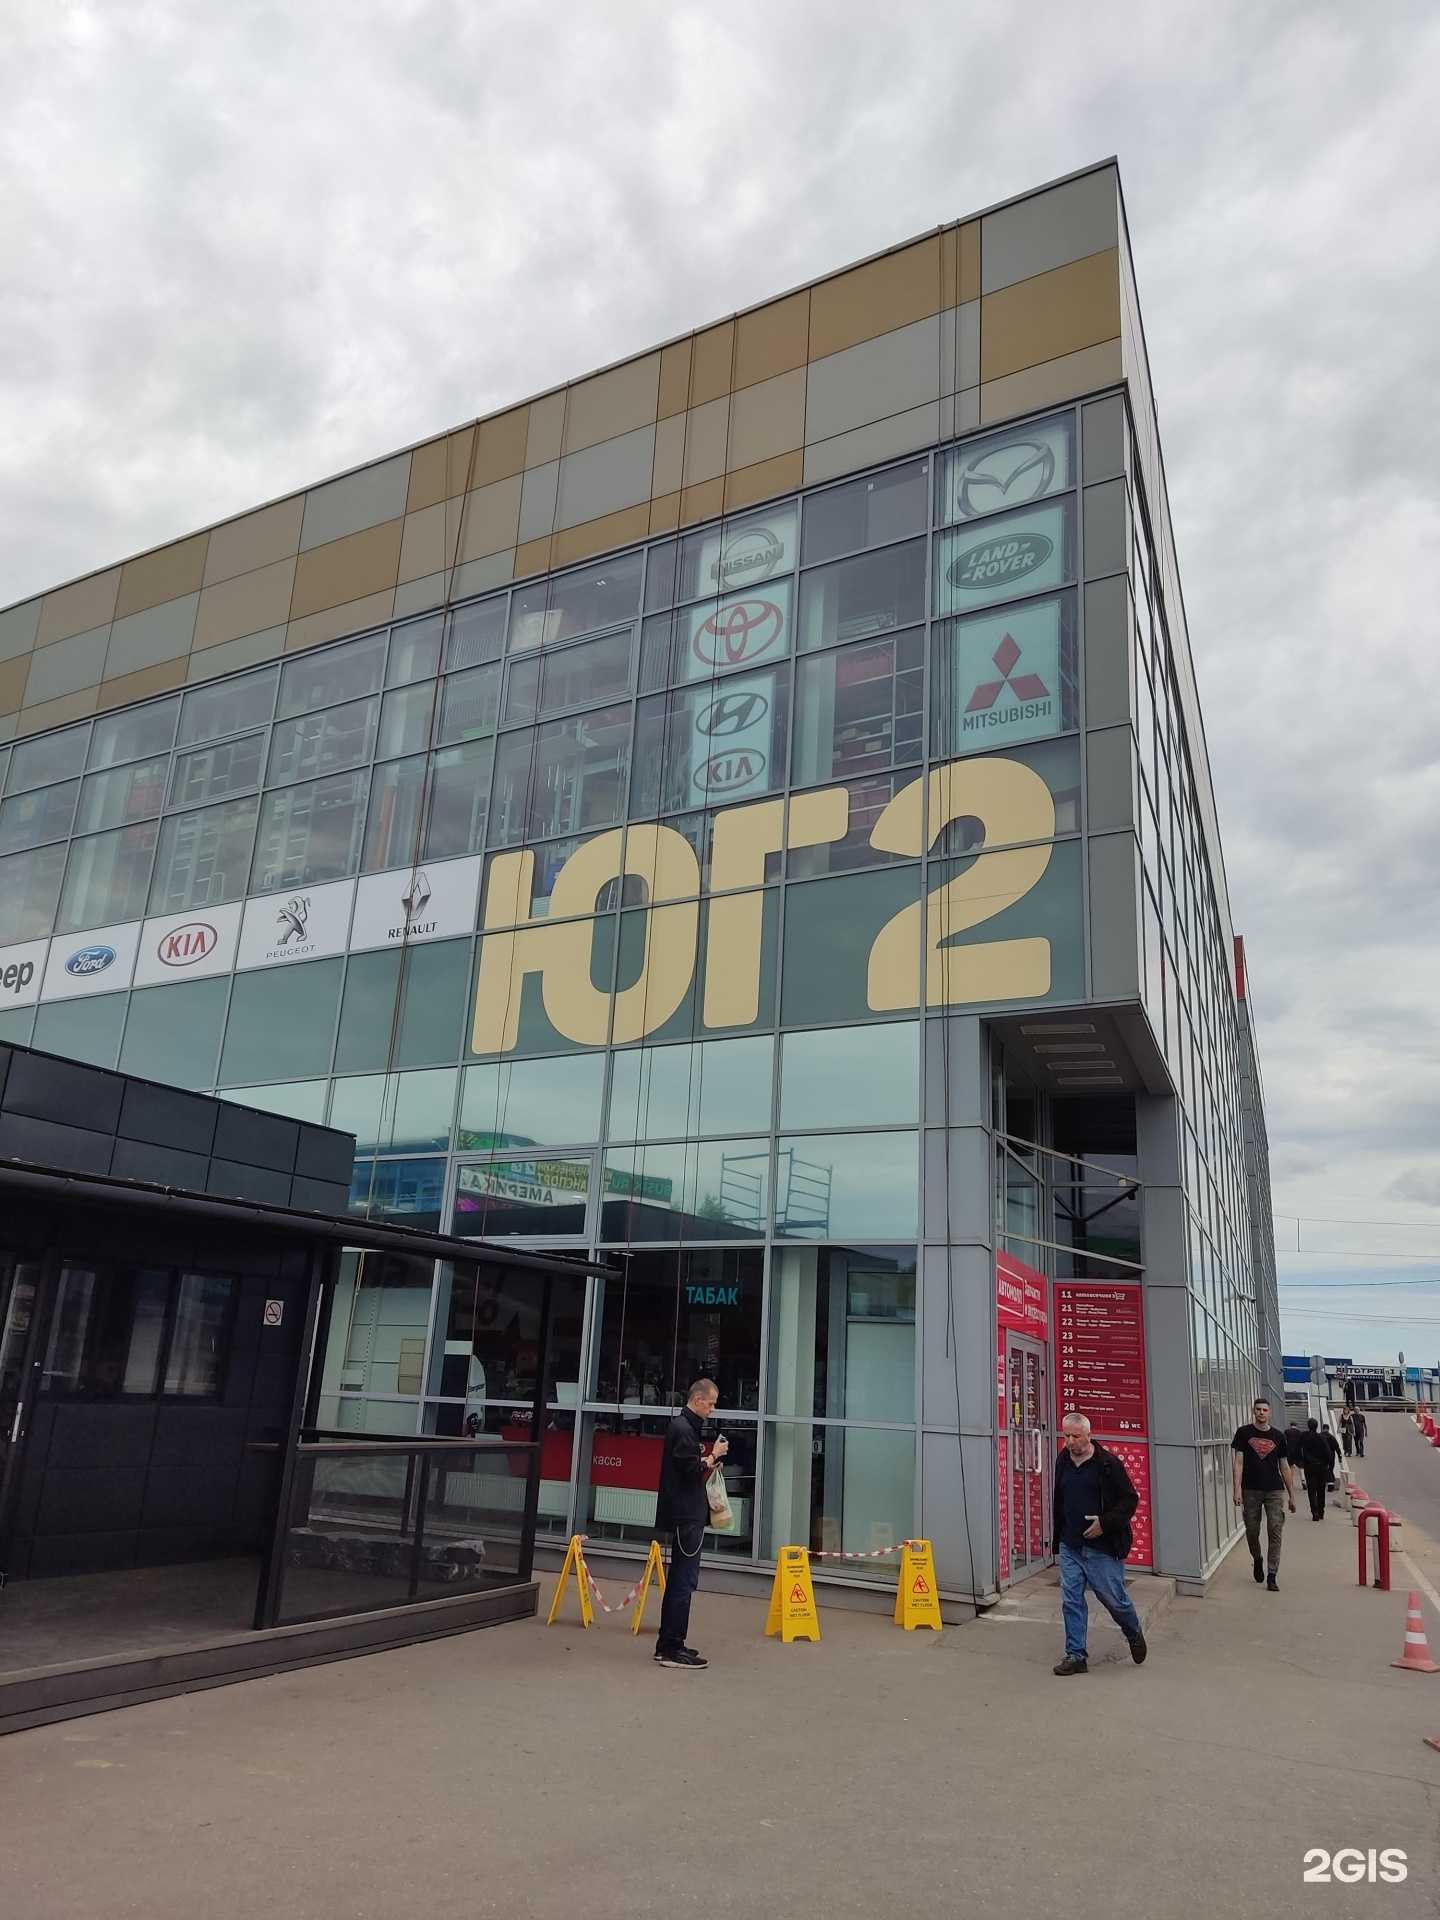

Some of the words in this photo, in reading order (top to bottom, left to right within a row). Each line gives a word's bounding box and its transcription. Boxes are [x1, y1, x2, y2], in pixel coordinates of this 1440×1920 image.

[719, 547, 777, 577] NISSAN
[971, 552, 1035, 581] ROVER
[963, 701, 1052, 731] MITSUBISHI
[708, 756, 752, 784] KIA
[388, 921, 438, 939] RENAULT
[166, 931, 206, 959] KIA
[266, 944, 315, 959] PEUGEOT
[72, 951, 105, 972] Ford
[0, 961, 34, 993] ep
[687, 1286, 738, 1305] ТАБАК
[1061, 1304, 1072, 1312] 21
[1062, 1318, 1073, 1326] 22
[1062, 1332, 1073, 1340] 23
[1062, 1346, 1073, 1354] 24
[1063, 1360, 1074, 1368] 25
[1063, 1374, 1074, 1382] 26
[1063, 1388, 1075, 1396] 27
[1064, 1403, 1075, 1411] 28
[592, 1455, 622, 1467] касса
